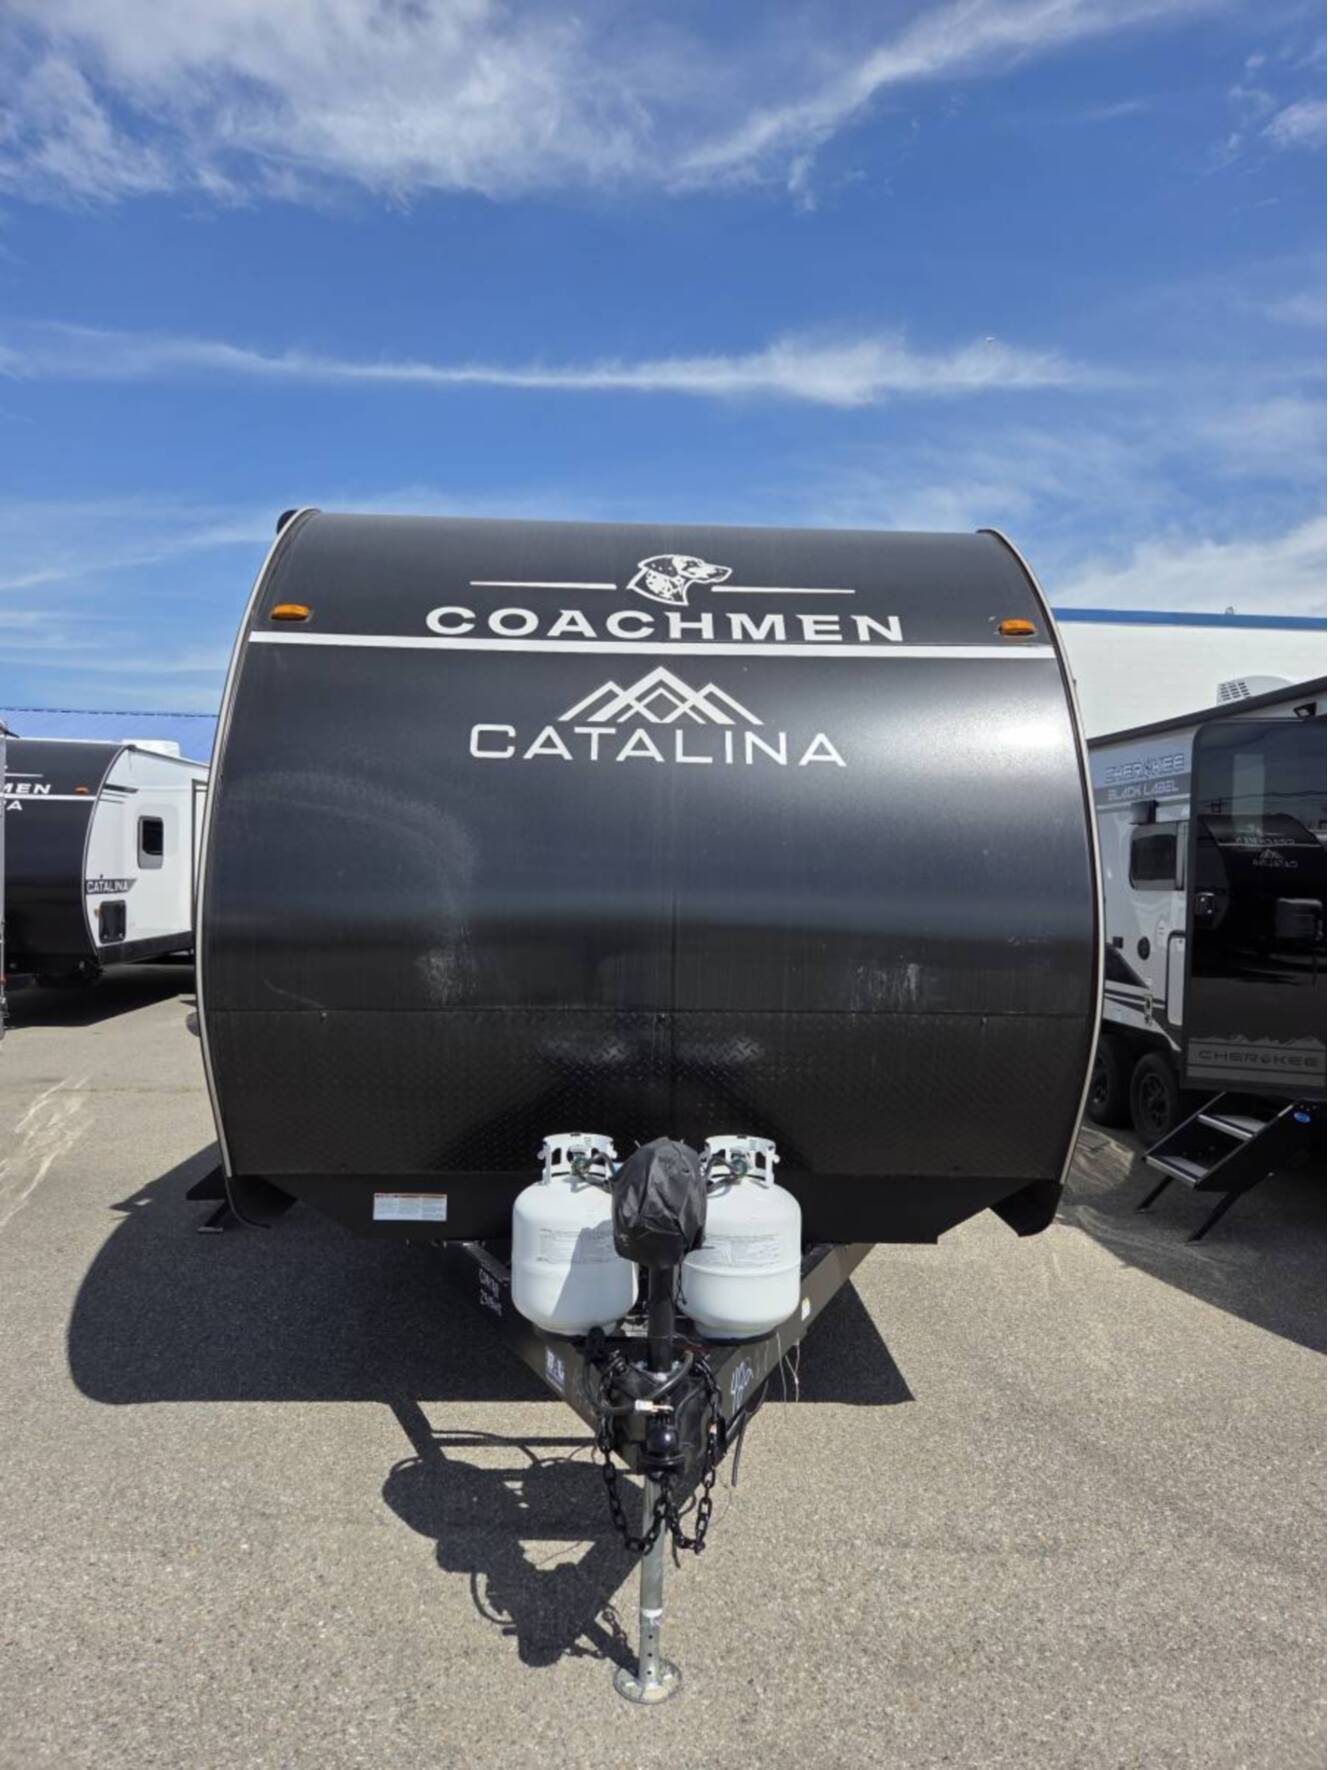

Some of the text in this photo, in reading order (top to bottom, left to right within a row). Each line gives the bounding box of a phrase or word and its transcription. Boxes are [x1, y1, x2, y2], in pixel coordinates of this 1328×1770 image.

[425, 606, 904, 643] COACHMEN
[469, 723, 847, 768] CATALINA
[86, 880, 129, 893] CATALINA
